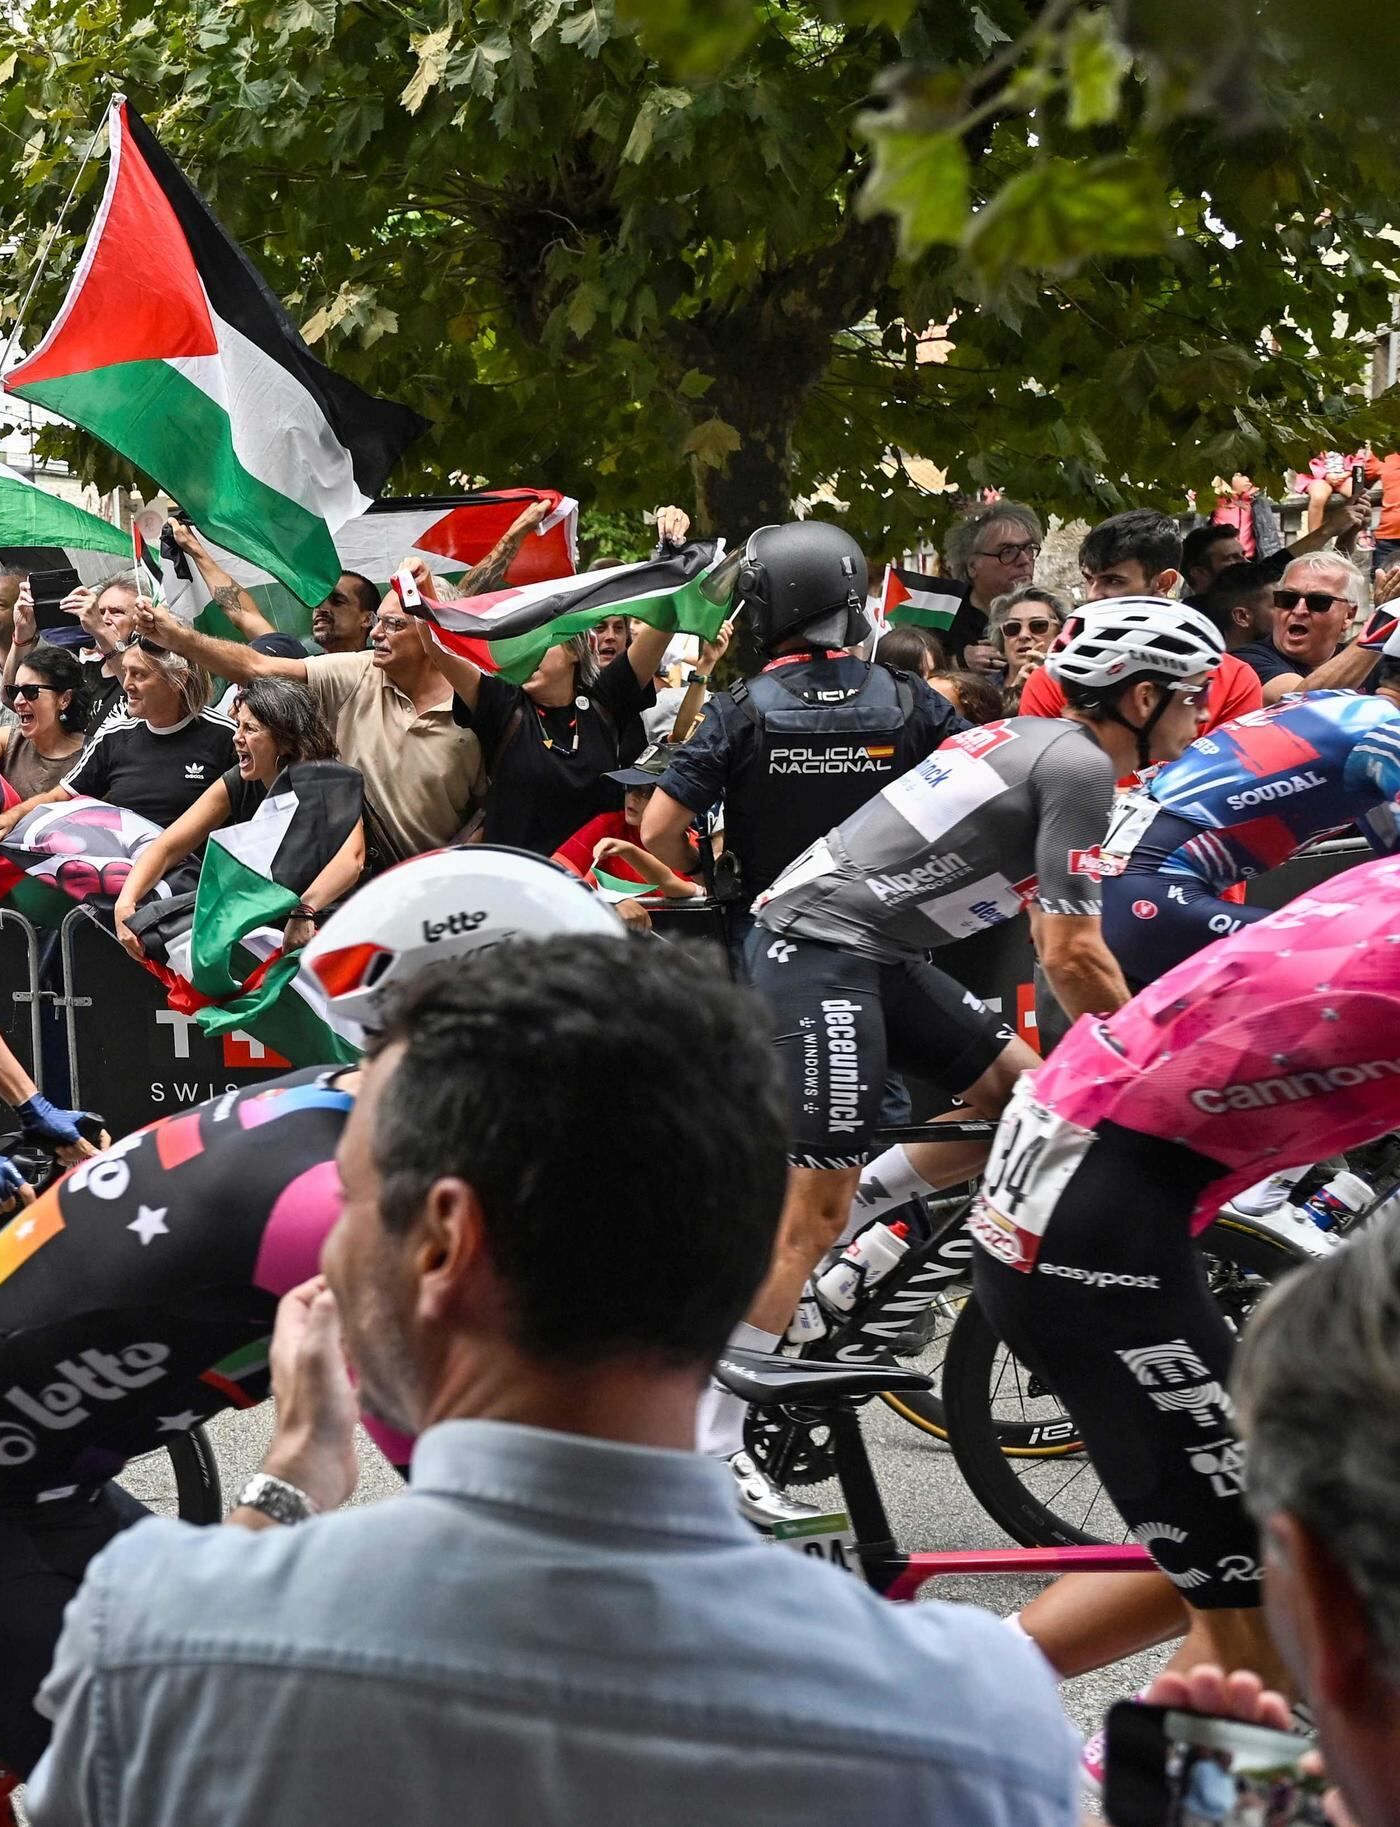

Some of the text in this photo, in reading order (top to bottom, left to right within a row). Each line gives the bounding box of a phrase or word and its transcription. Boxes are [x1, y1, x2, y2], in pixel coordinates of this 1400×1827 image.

[1129, 650, 1188, 671] CANYON
[769, 760, 892, 774] NACIONAL
[770, 747, 869, 760] POLICIA
[1227, 771, 1327, 810] SOUDAL
[865, 852, 968, 901] Alpecin
[422, 911, 487, 943] lotto
[803, 1033, 819, 1097] WINDOWS
[821, 1000, 869, 1133] deceuninck
[1037, 1261, 1161, 1289] easypost
[4, 1342, 171, 1430] lotto
